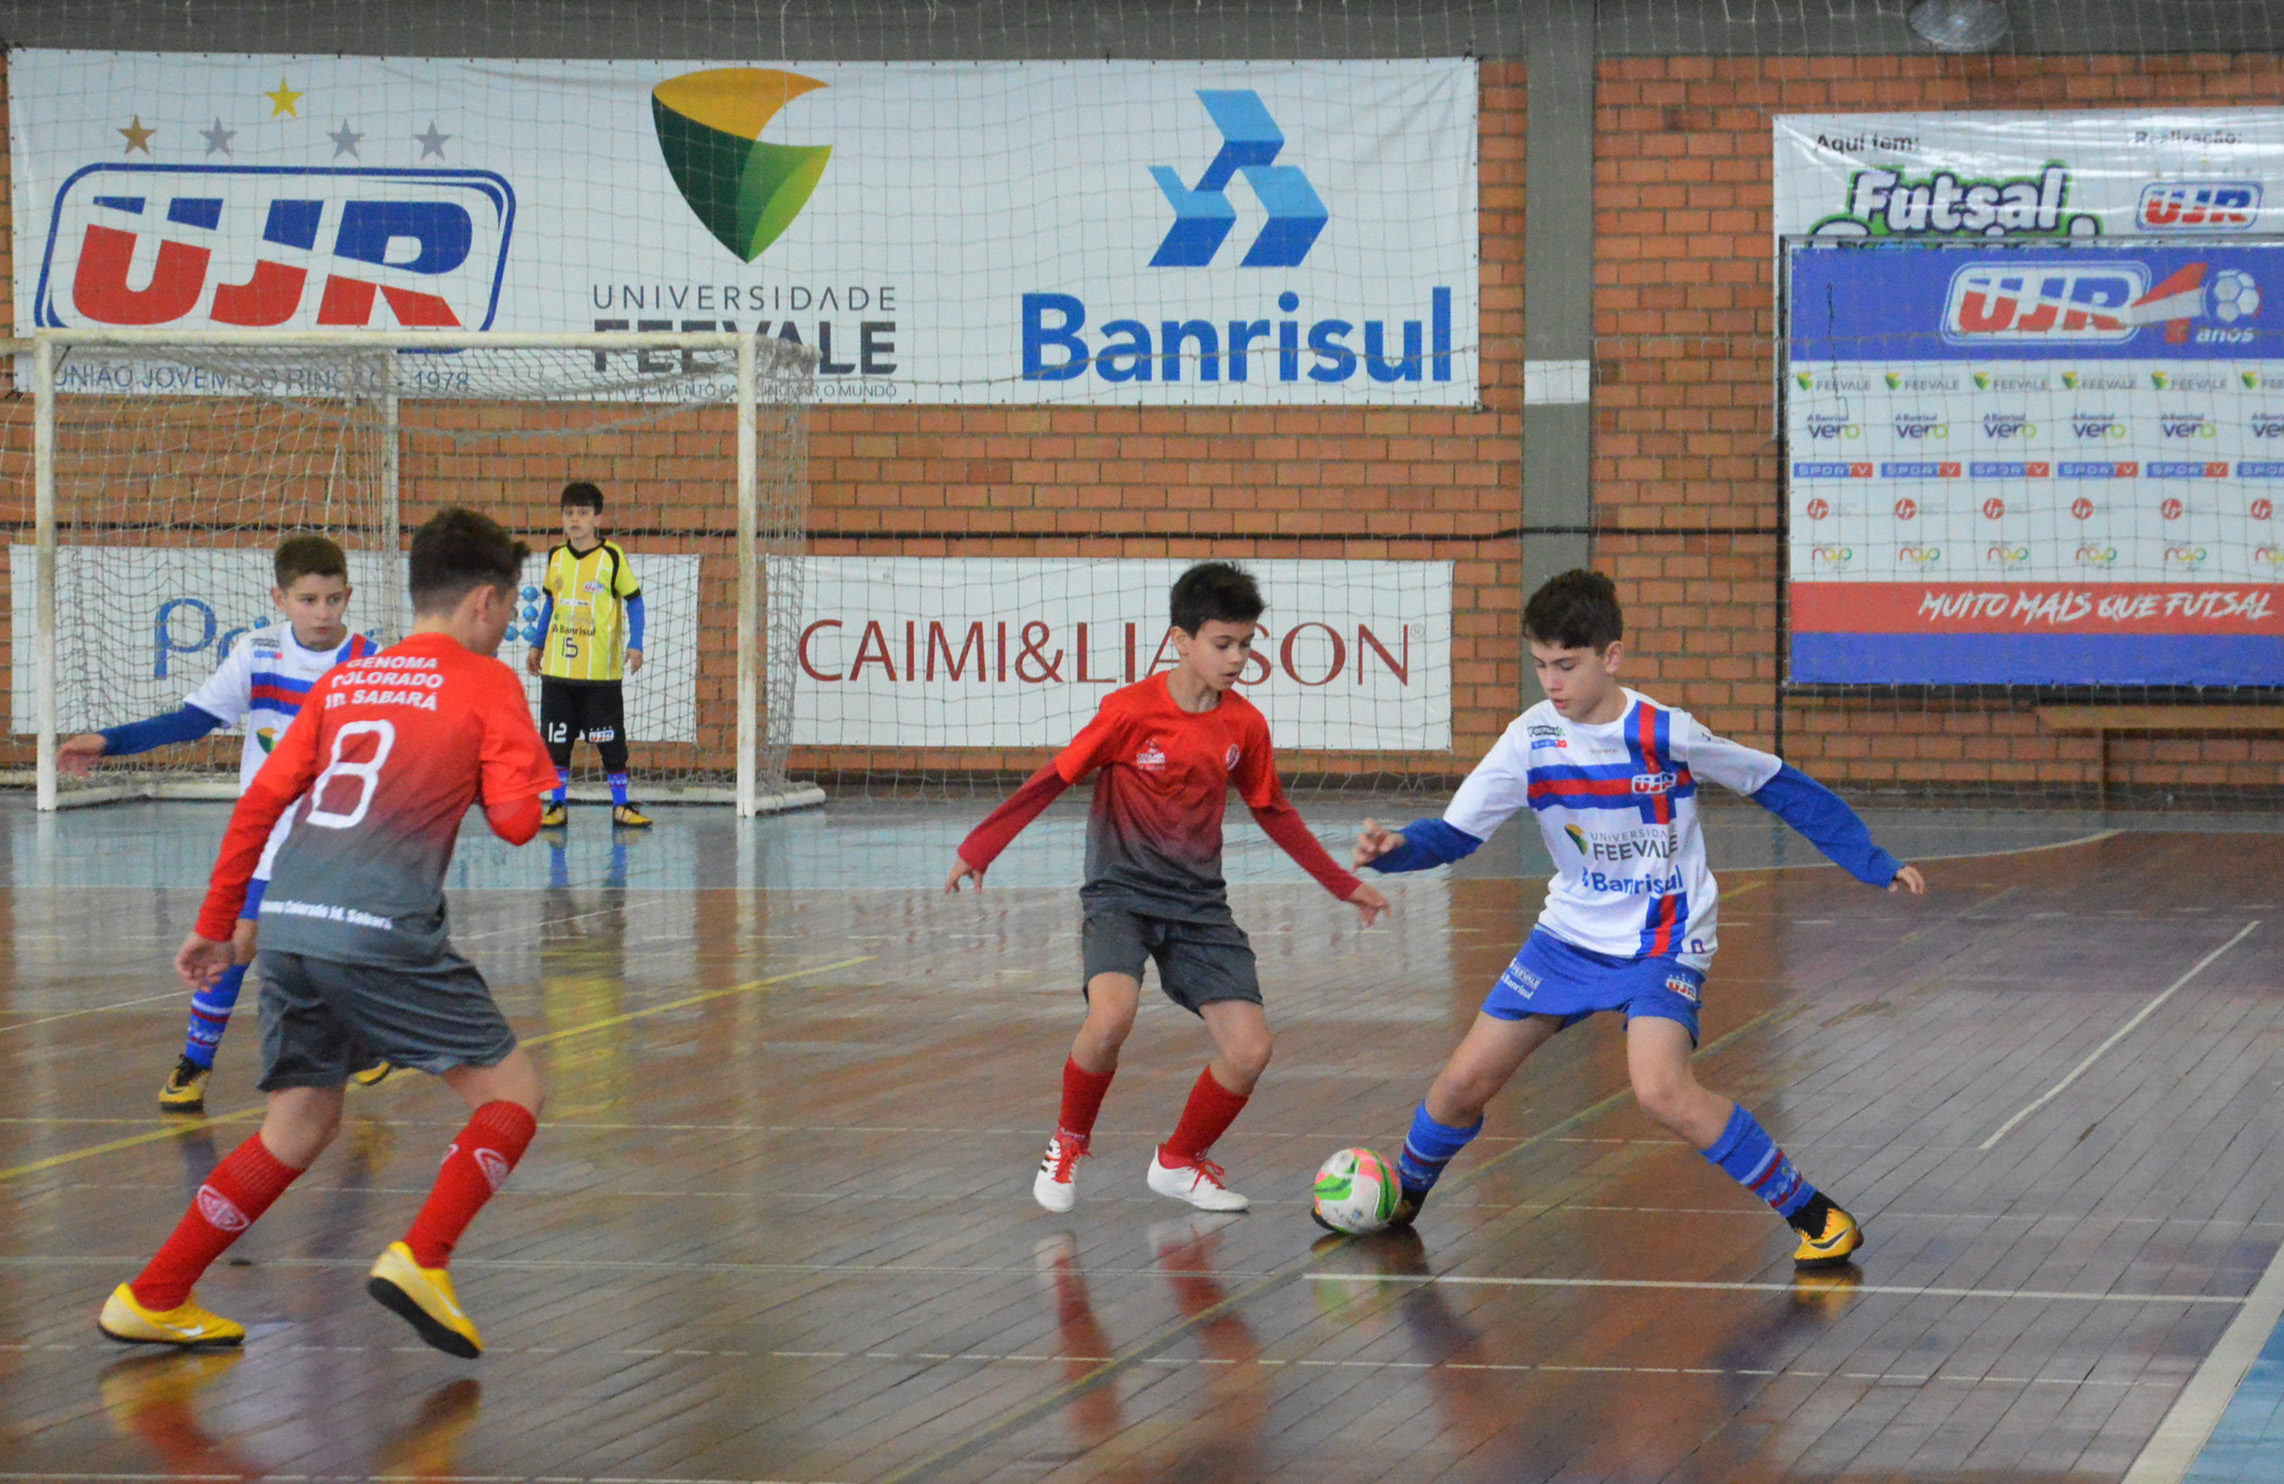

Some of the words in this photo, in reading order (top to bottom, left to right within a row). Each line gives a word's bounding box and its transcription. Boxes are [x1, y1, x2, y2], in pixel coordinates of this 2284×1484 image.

[1852, 161, 2067, 234] Futsal
[2145, 188, 2250, 224] UJR
[71, 196, 473, 327] UJR
[593, 284, 897, 312] UNIVERSIDADE
[1957, 276, 2130, 333] UJR
[1021, 286, 1452, 383] Banrisul
[2196, 327, 2255, 343] anos
[413, 370, 470, 392] 1978
[825, 383, 836, 397] O
[839, 383, 897, 397] MUNDO
[1815, 379, 1871, 391] FEEVALE
[1903, 379, 1960, 391] FEEVALE
[1807, 423, 1860, 439] vero
[1895, 423, 1949, 439] vero
[1984, 423, 2037, 439] vero
[2072, 423, 2127, 439] vero
[2161, 423, 2216, 439] vero
[1918, 590, 2009, 622] MUITO
[2011, 589, 2092, 625] MAIS
[2097, 592, 2165, 622] QUE
[2164, 590, 2274, 621] FUTSAL
[346, 655, 438, 670] GENOMA
[799, 618, 1411, 687] CAIMI&LIASON
[331, 671, 444, 689] COLORADO
[351, 689, 437, 711] SABARÁ
[548, 721, 568, 743] 12
[305, 719, 396, 830] 8
[1634, 774, 1676, 792] UJR
[1593, 834, 1678, 861] FEEVALE
[1591, 864, 1684, 895] Banrisul
